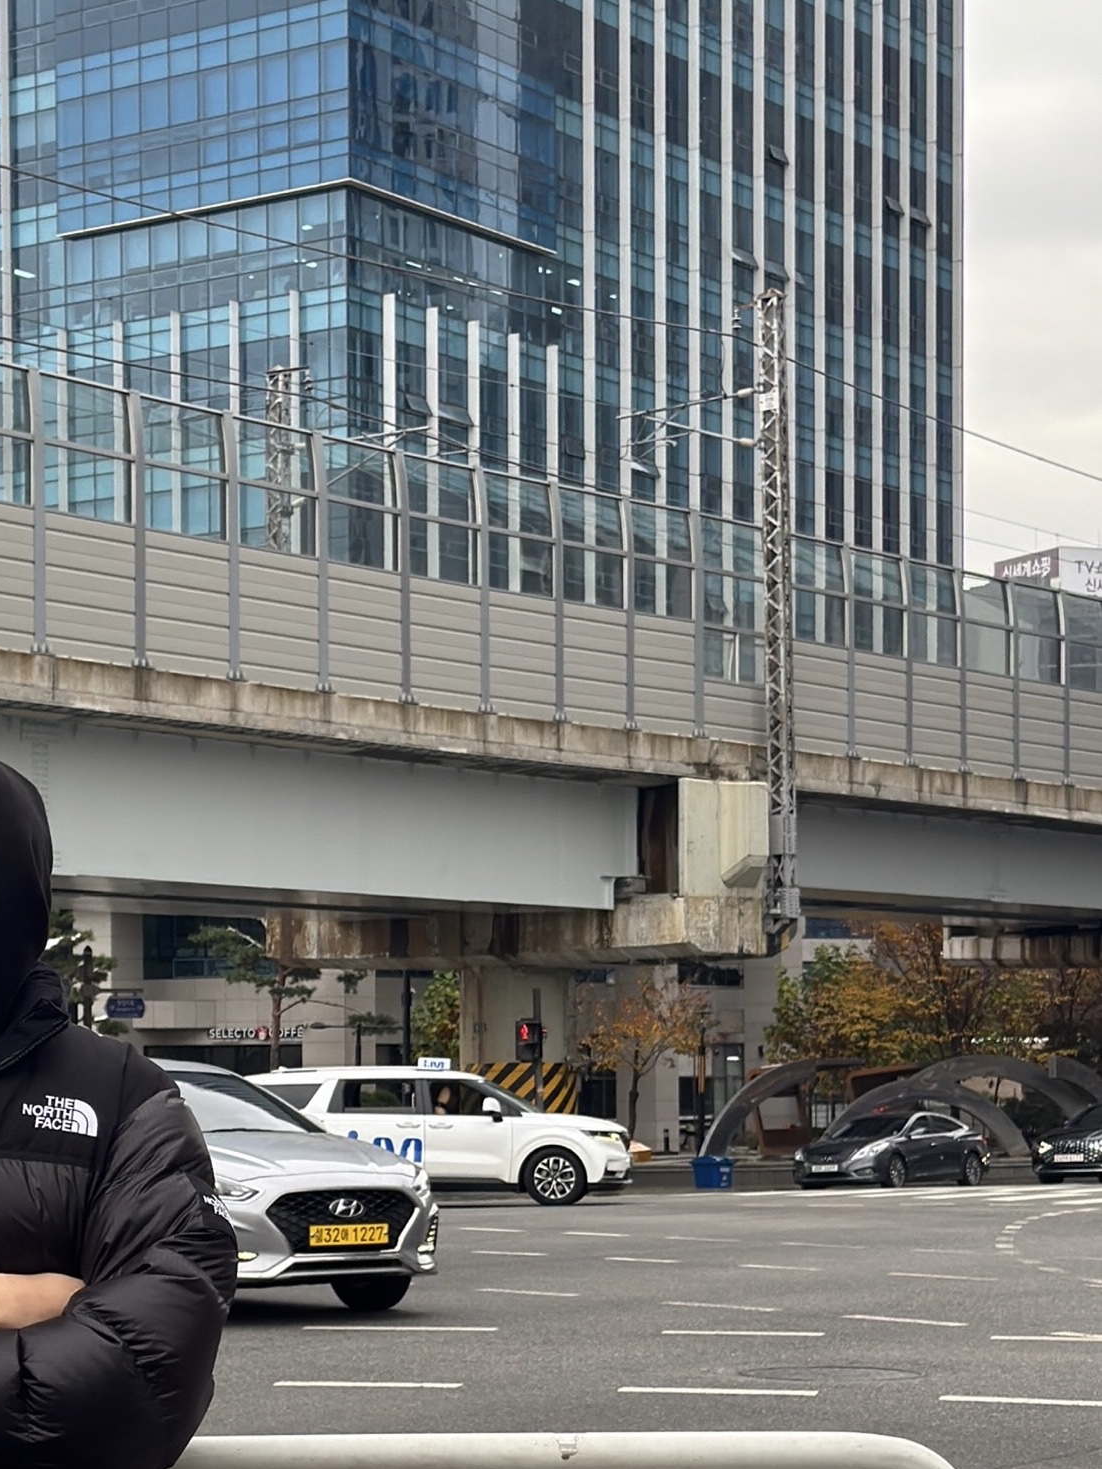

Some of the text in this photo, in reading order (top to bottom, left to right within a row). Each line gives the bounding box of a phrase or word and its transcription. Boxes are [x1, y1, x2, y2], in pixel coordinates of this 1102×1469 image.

[209, 1028, 256, 1039] SELECTO
[45, 1095, 75, 1110] THE
[22, 1103, 73, 1121] NORTH
[34, 1116, 73, 1133] FACE
[352, 1226, 384, 1242] 1227
